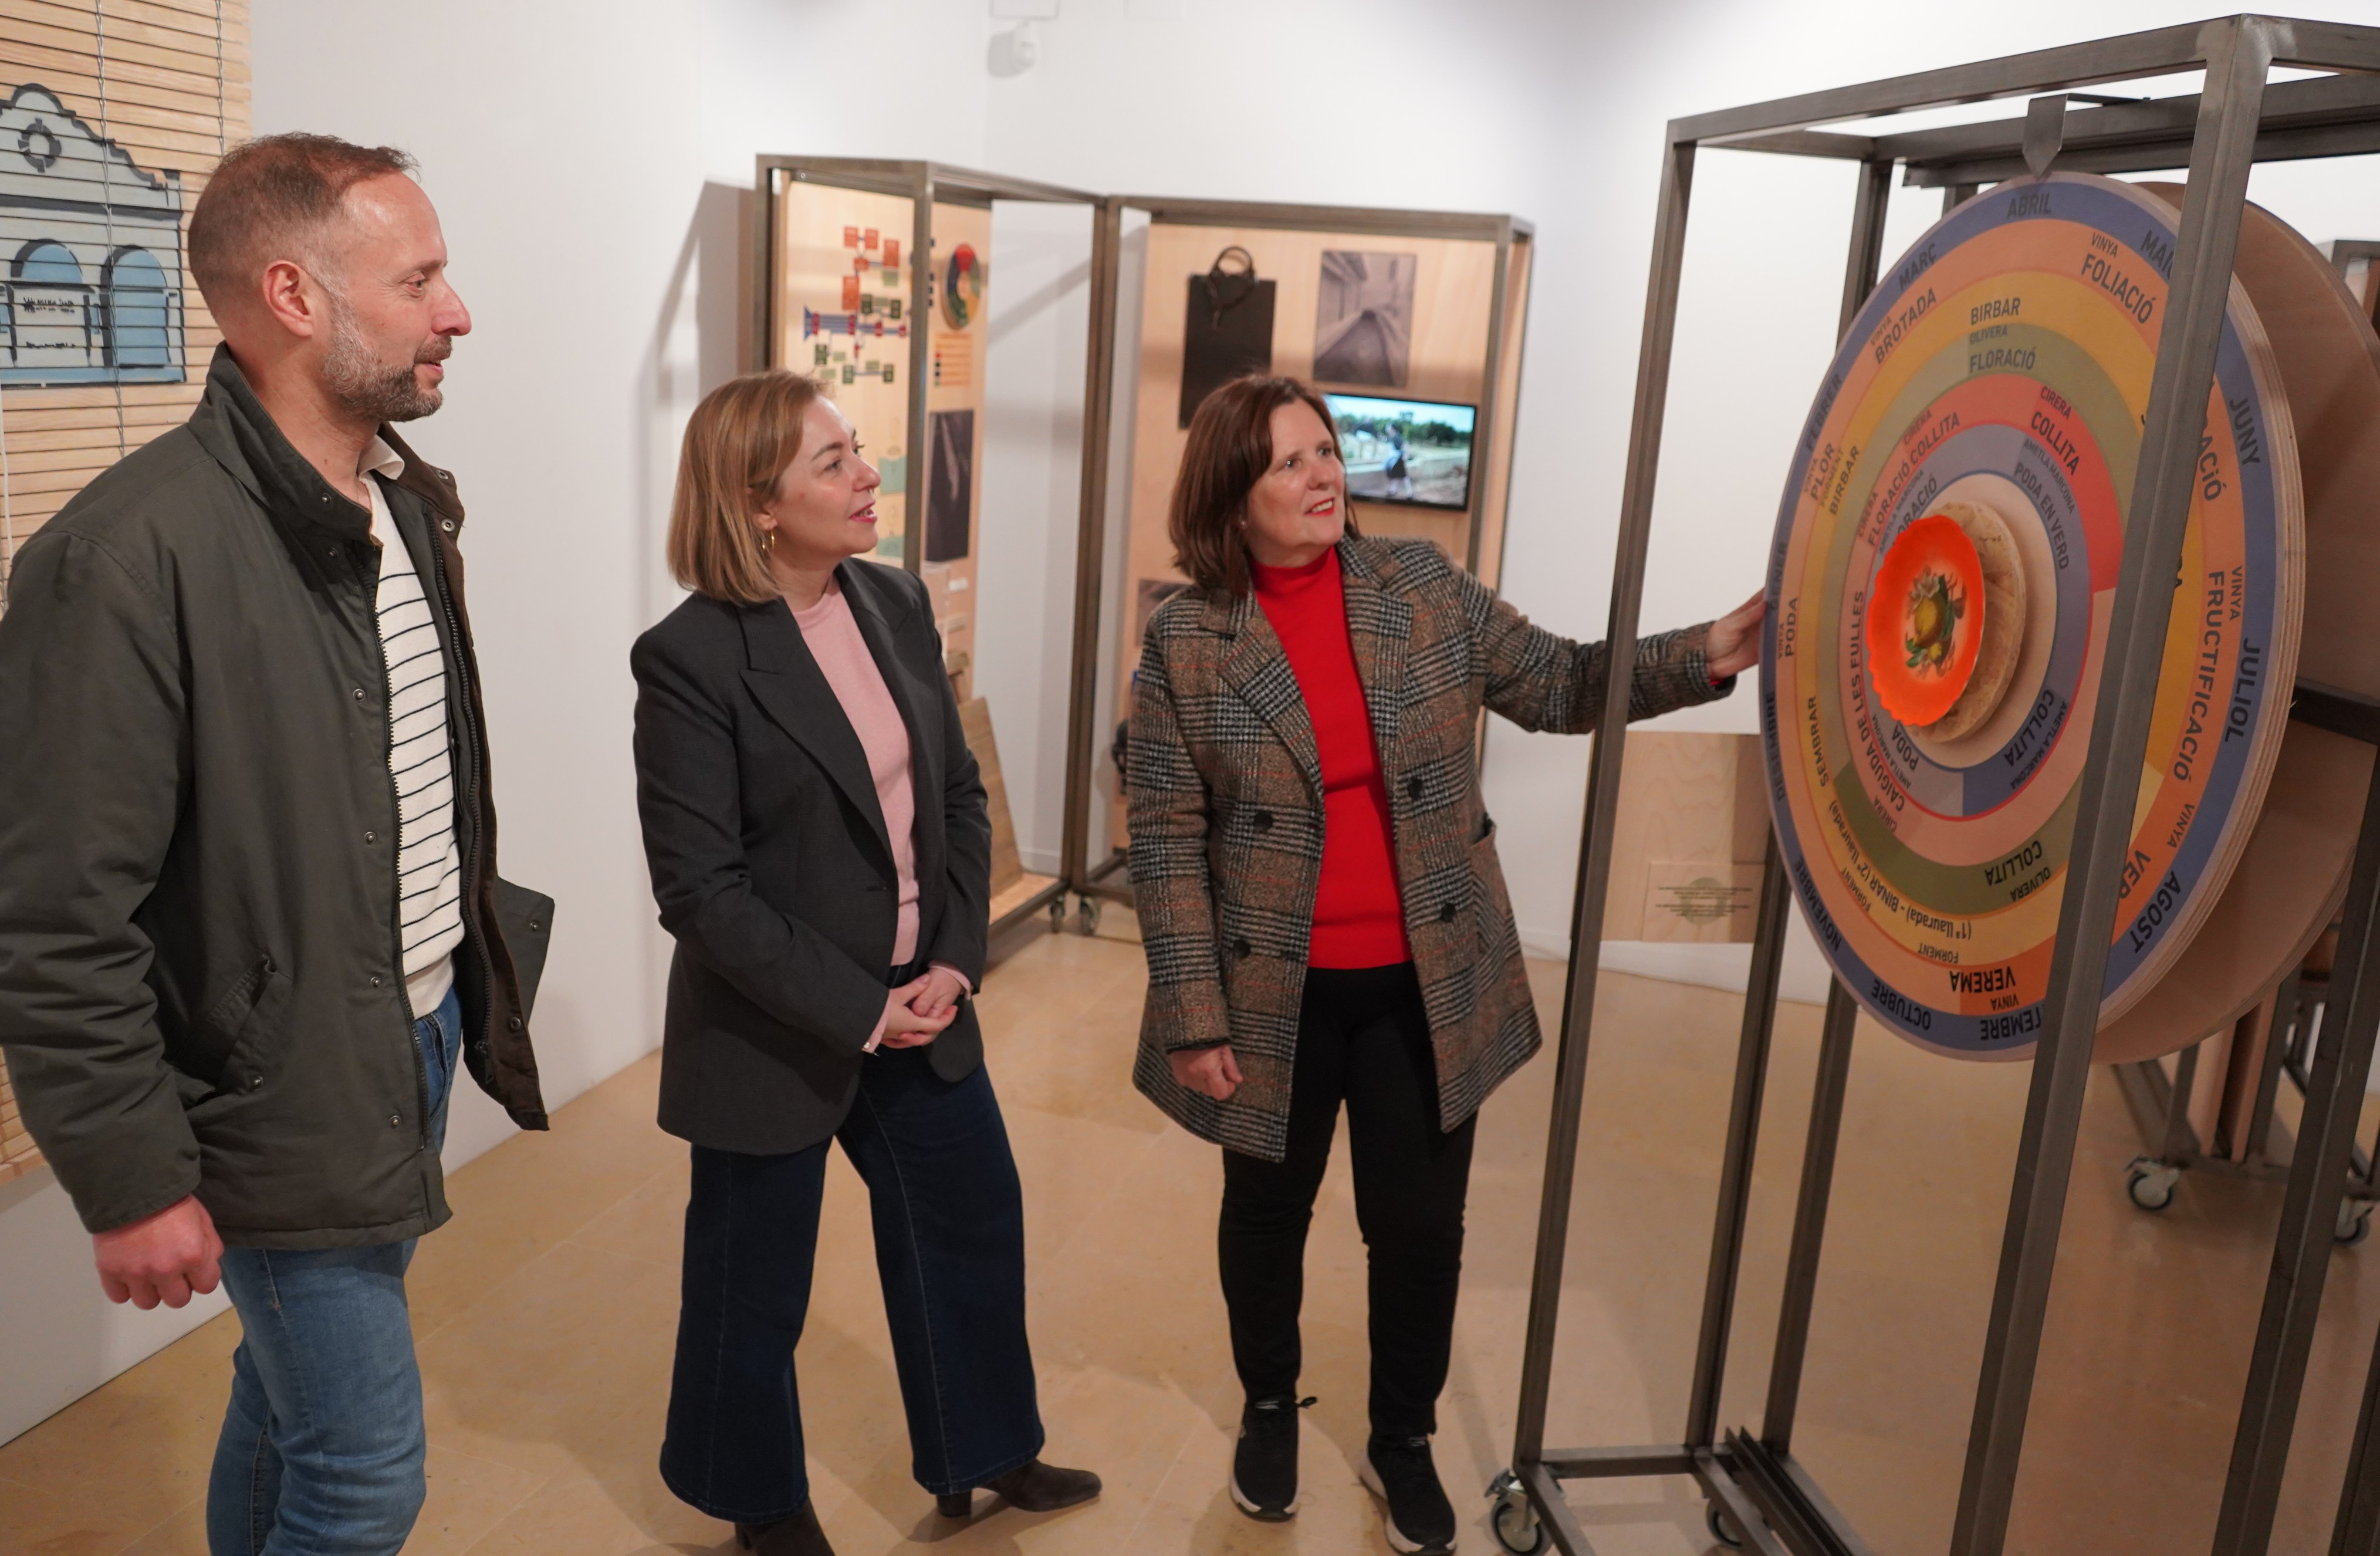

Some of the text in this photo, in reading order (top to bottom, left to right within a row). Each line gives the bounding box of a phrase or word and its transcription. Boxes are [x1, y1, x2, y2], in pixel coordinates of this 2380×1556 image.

[2007, 193, 2051, 219] ABRIL
[1899, 243, 1936, 290] MARÇ
[2091, 232, 2119, 258] VINYA
[2141, 230, 2174, 280] MAI
[1971, 298, 2021, 325] BIRBAR
[2081, 254, 2156, 324] FOLIACIÓ
[1870, 316, 1892, 346] VINYA
[1875, 288, 1936, 364] BROTADA
[1969, 325, 2007, 345] OLIVERA
[1970, 347, 2036, 373] FLORACIÓ
[1806, 374, 1841, 451] FEBRER
[1904, 409, 1932, 446] CIRERA
[2040, 386, 2071, 420] CIRERA
[1910, 411, 1960, 465] COLLITA
[2031, 411, 2080, 475] COLLITA
[2230, 397, 2260, 466] JUNY
[1804, 457, 1818, 493] VINYA
[1811, 443, 1835, 500] PLOR
[1820, 448, 1844, 507] FORMENT
[1830, 445, 1860, 515] BIRBAR
[2049, 464, 2075, 514] MARCONA
[1858, 492, 1878, 538] CIRERA
[1868, 460, 1910, 546] FLORACIÓ
[2014, 462, 2070, 570] PODA EN VERD
[2230, 565, 2243, 621] VINYA
[1786, 598, 1798, 657] PODA
[1850, 591, 1905, 812] CAIGUDA DE LES FULLES
[2173, 571, 2225, 782] FRUCTIFICACIÓ
[2225, 637, 2260, 742] JULIOL
[1766, 691, 1786, 801] DESEMBRE
[1808, 696, 1829, 787] SEMBRAR
[1891, 724, 1919, 771] PODA
[2004, 689, 2054, 767] COLLITA
[2010, 748, 2045, 789] MARCONA
[1828, 799, 1860, 865] llaurada)
[1873, 796, 1898, 832] CIRERA
[2167, 803, 2195, 848] VINYA
[1985, 840, 2042, 886] COLLITA
[2010, 866, 2051, 902] OLIVERA
[1795, 856, 1842, 951] NOVEMBRE
[1840, 867, 1872, 912] FORMENT
[1869, 877, 1900, 913] BINAR
[2129, 870, 2181, 954] AGOST
[1906, 904, 1953, 938] llaurada)
[1918, 942, 1959, 964] FORMENT
[1871, 978, 1931, 1031] OCTUBRE
[1949, 966, 2016, 993] VEREMA
[1990, 993, 2019, 1011] VINYA
